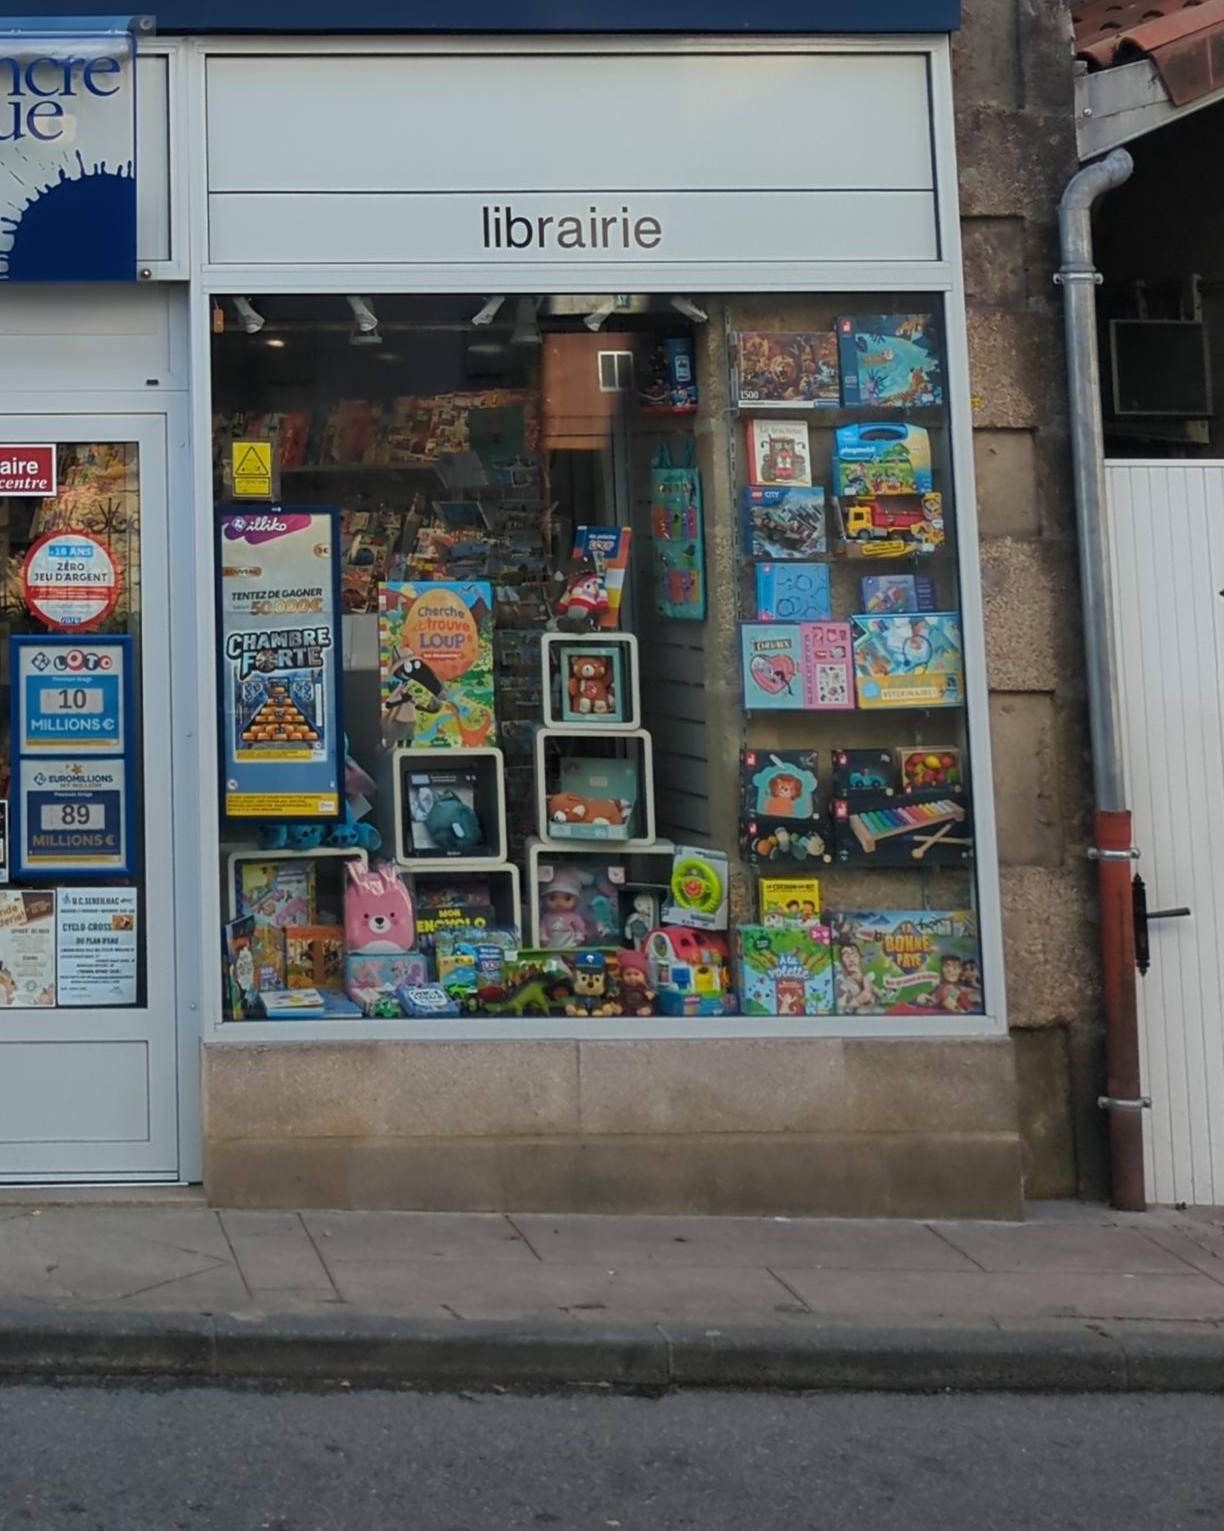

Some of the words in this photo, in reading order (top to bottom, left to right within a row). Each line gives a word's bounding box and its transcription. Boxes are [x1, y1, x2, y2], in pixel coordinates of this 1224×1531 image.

[482, 206, 662, 249] librairie
[246, 516, 288, 531] illiko
[57, 559, 85, 572] ZÉRO
[35, 573, 53, 582] JEU
[55, 573, 108, 582] D'ARGENT
[232, 591, 267, 601] TENTEZ
[268, 590, 281, 599] DE
[282, 588, 323, 598] GAGNER
[418, 605, 465, 619] Cherche
[427, 617, 470, 632] trouve
[227, 628, 330, 659] CHAMBRE
[419, 632, 466, 649] LOUP
[54, 649, 113, 671] LOTO
[58, 689, 87, 709] 10
[31, 718, 100, 731] MILLIONS
[48, 774, 114, 783] EUROMILLIONS
[62, 804, 90, 825] 89
[32, 834, 101, 847] MILLIONS
[885, 935, 931, 952] BONNE
